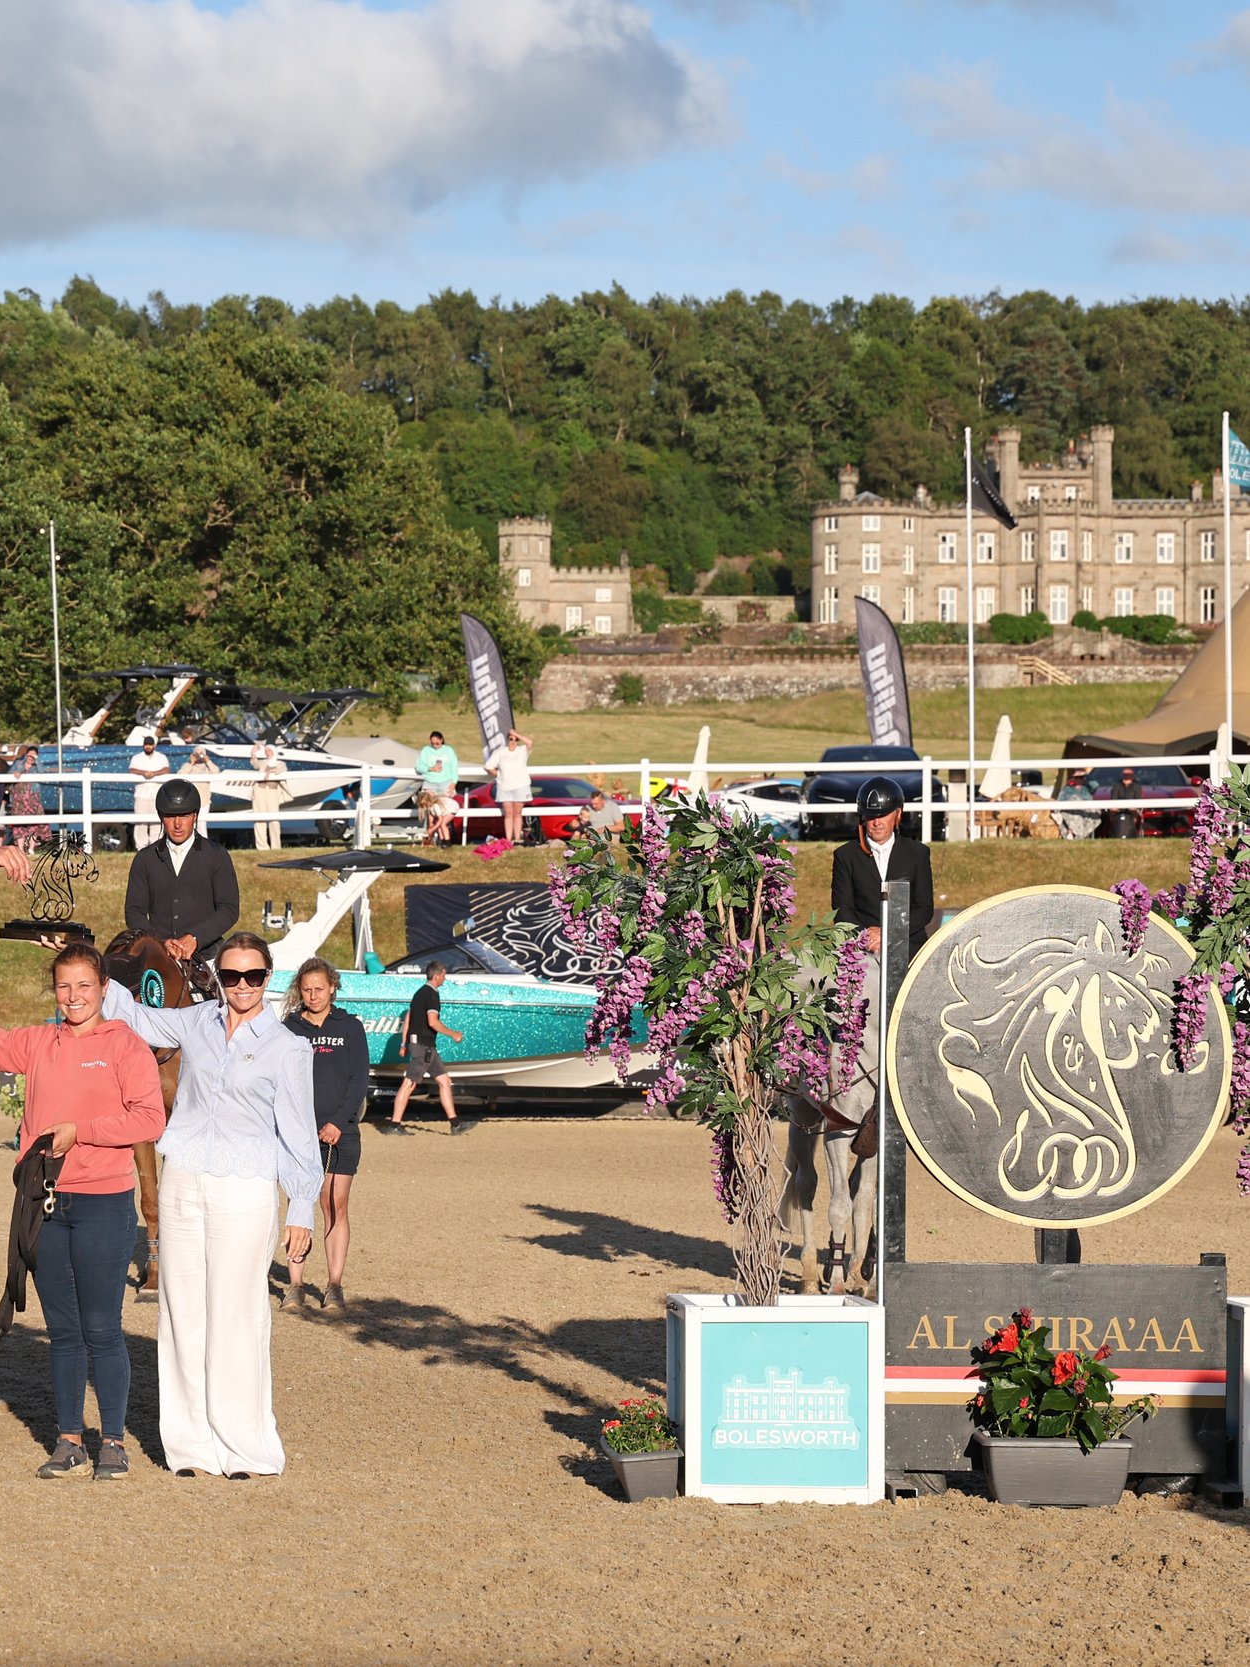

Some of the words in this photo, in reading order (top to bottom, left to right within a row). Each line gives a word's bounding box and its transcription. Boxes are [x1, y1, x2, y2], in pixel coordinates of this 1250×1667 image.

[356, 1016, 404, 1034] alib
[308, 1036, 344, 1046] LLISTER
[906, 1314, 972, 1350] AL
[983, 1315, 1205, 1353] SIRA'AA
[715, 1429, 856, 1445] BOLESWORTH
